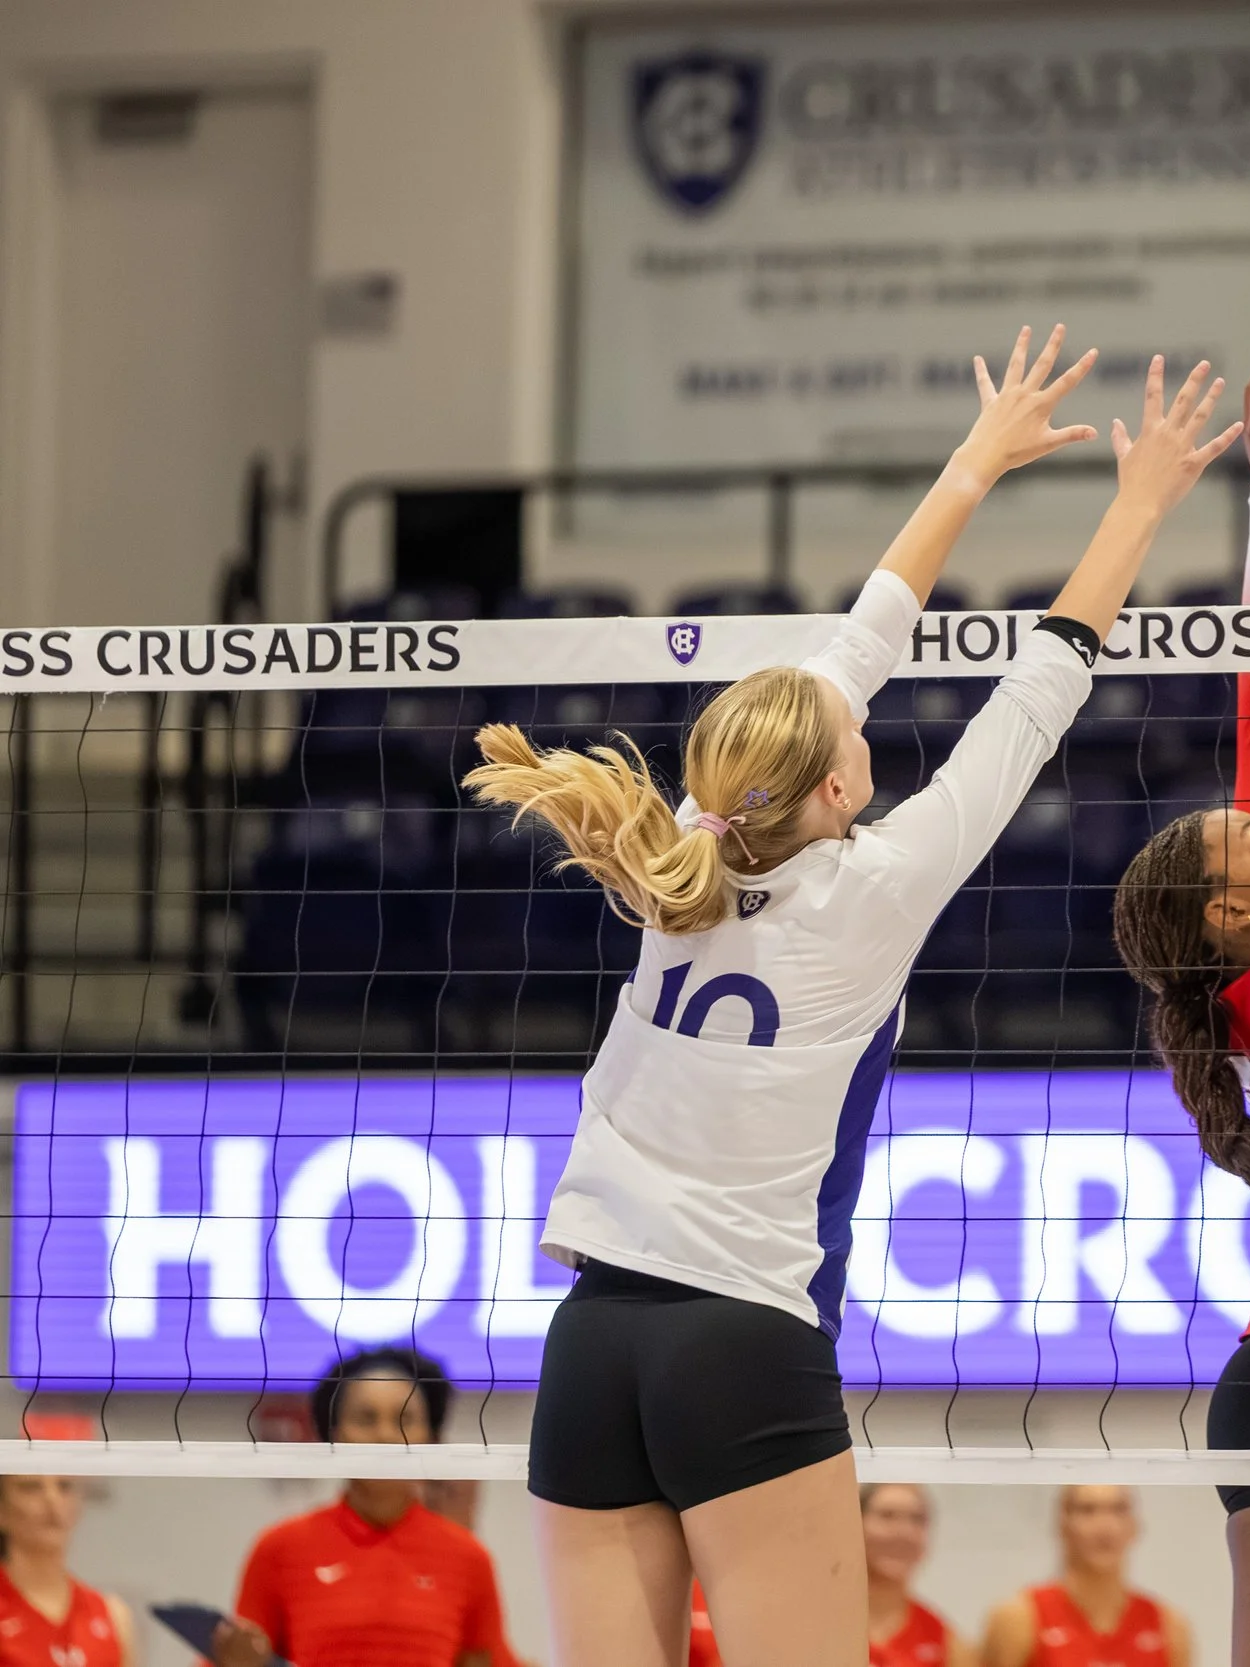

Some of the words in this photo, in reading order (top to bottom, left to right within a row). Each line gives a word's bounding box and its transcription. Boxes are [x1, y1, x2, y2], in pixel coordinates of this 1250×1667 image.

[97, 625, 461, 676] CRUSADERS
[911, 614, 1046, 662] HOL
[97, 1131, 578, 1341] HOL
